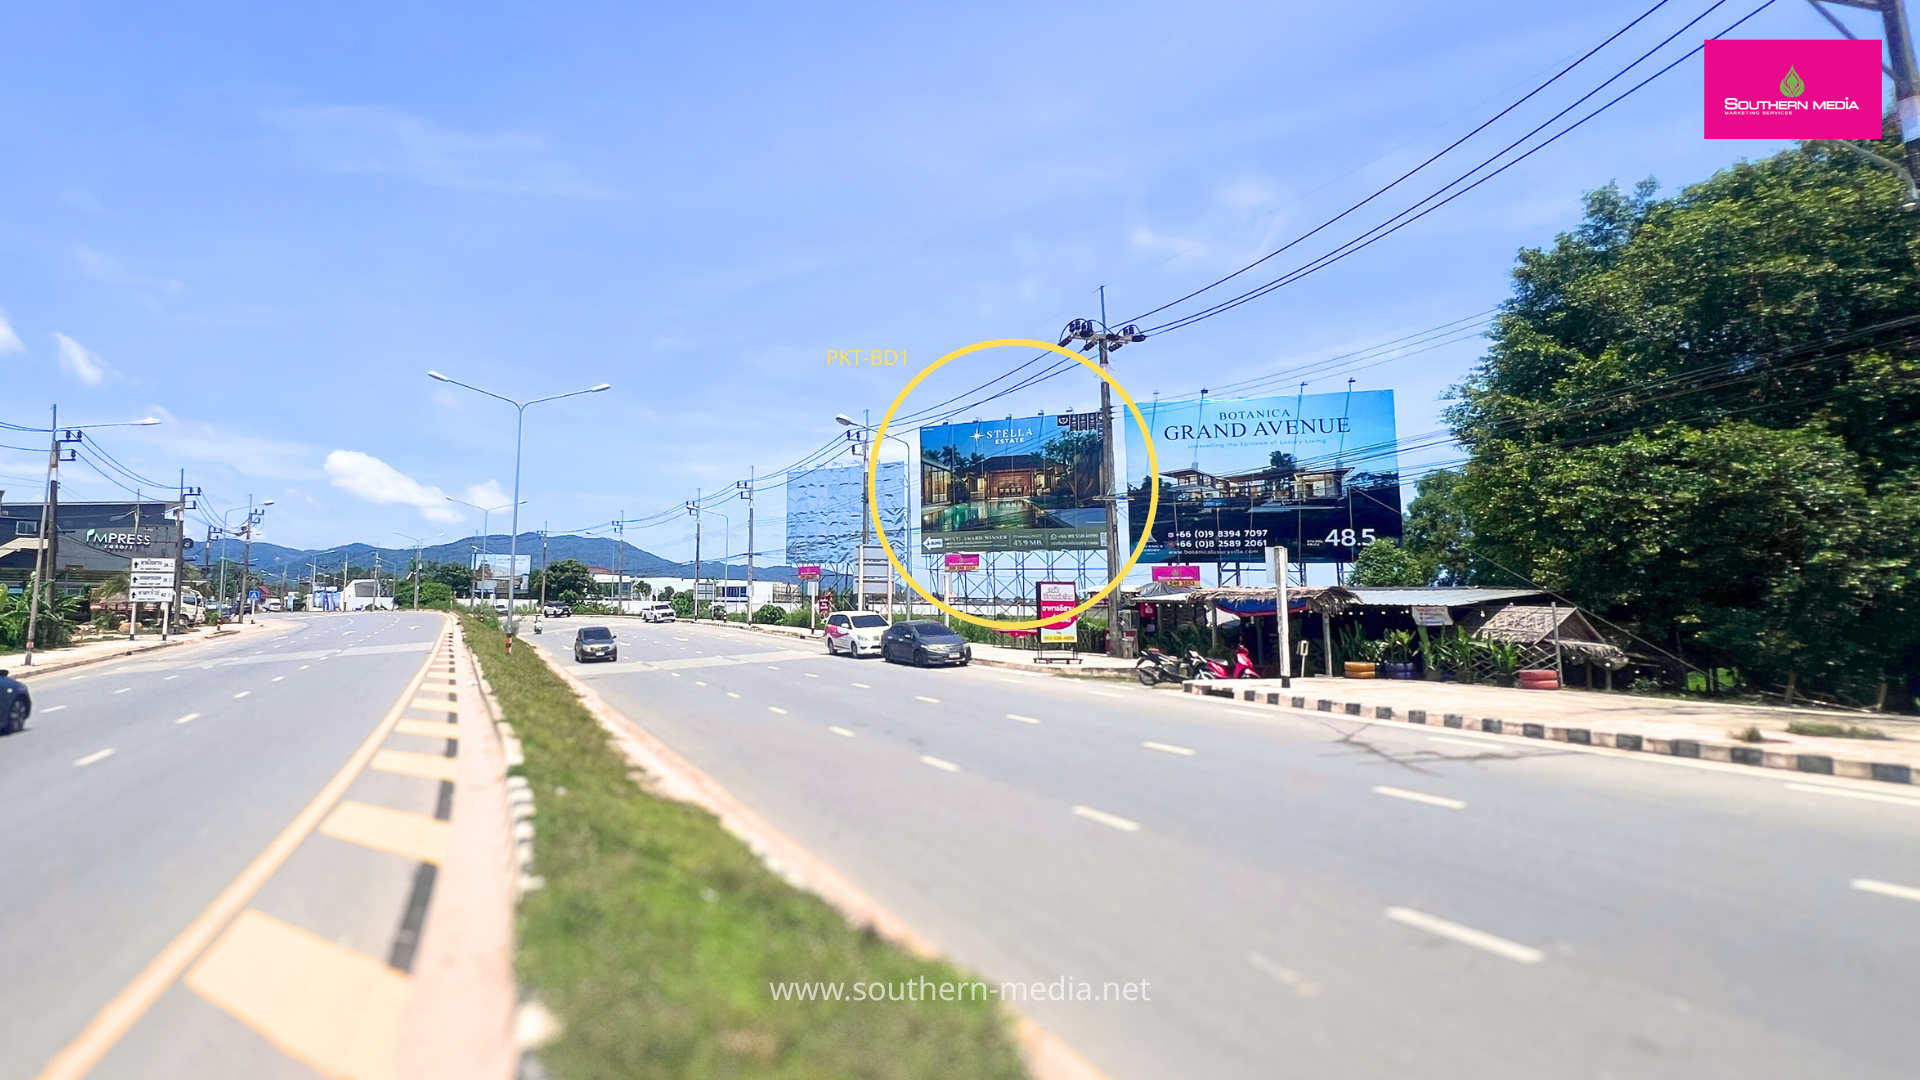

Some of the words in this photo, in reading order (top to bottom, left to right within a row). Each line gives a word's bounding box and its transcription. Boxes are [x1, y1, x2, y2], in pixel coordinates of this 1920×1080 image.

[1219, 409, 1291, 421] BOTANICA
[986, 427, 1033, 439] STELLA
[1163, 422, 1247, 441] GRAND
[1253, 417, 1351, 437] AVENUE
[995, 437, 1025, 445] ESTATE
[1194, 530, 1214, 539] (0)9
[1217, 530, 1241, 538] 8394
[1244, 529, 1268, 537] 7097
[1325, 528, 1376, 547] 48.5
[1175, 540, 1192, 548] +66
[1195, 540, 1215, 548] (0)8
[1218, 540, 1241, 548] 2589
[1244, 539, 1267, 547] 2061
